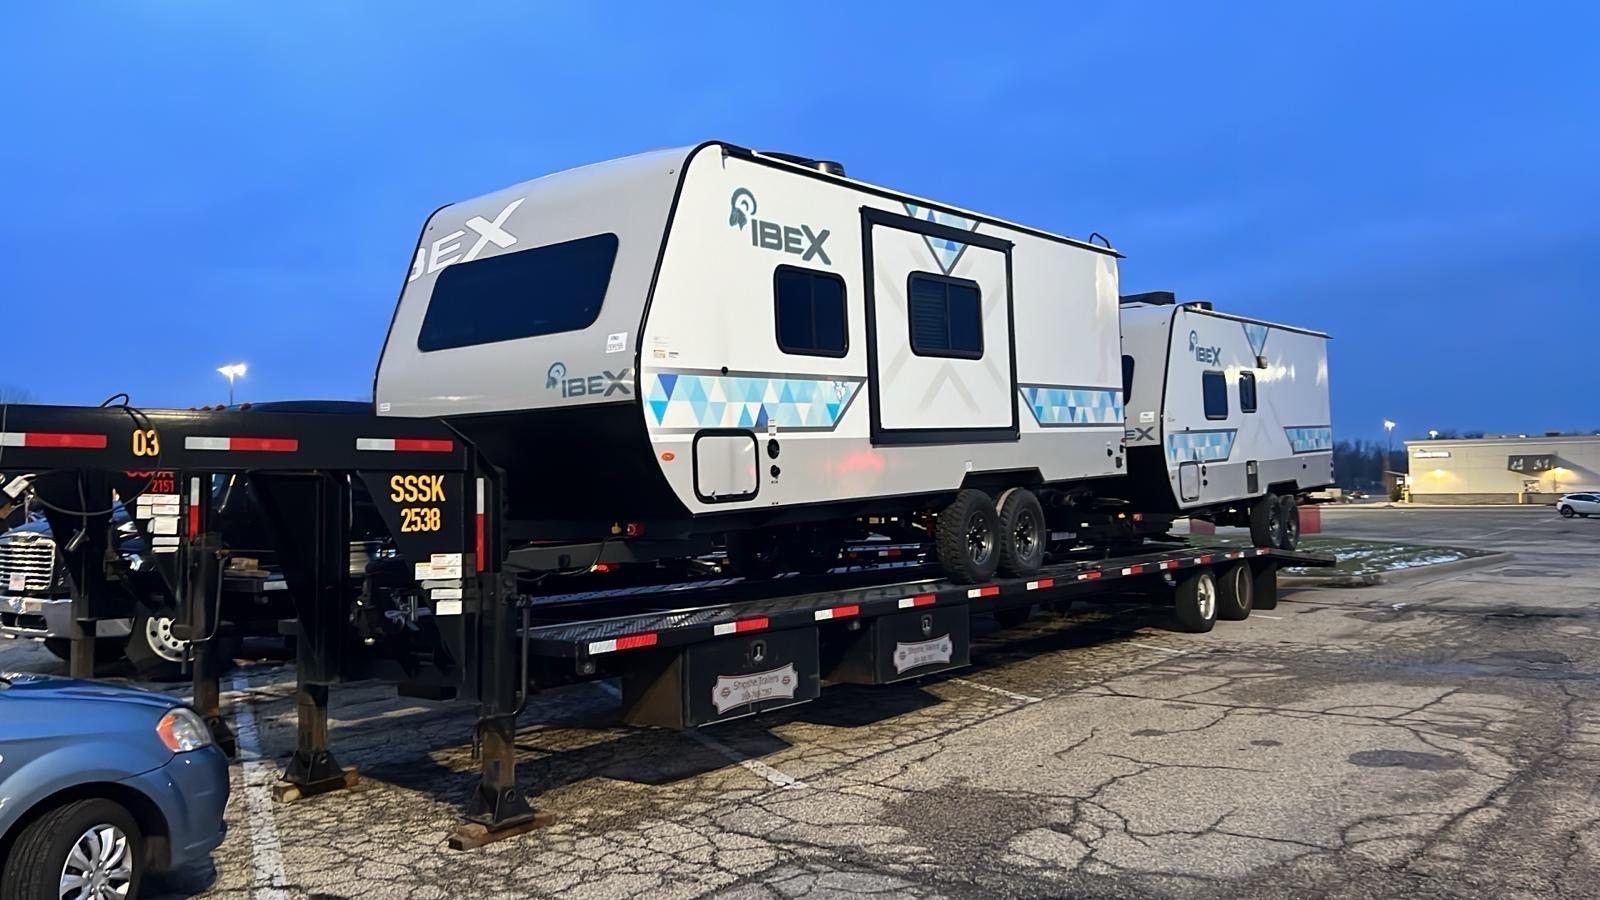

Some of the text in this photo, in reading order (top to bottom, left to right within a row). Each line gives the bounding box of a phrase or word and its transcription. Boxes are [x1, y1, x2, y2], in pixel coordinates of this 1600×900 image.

[751, 218, 832, 266] IBEX
[1195, 346, 1221, 367] IBEX
[562, 368, 631, 398] IBEX
[132, 429, 160, 456] 03
[390, 474, 446, 503] SSSK
[400, 507, 441, 533] 2538
